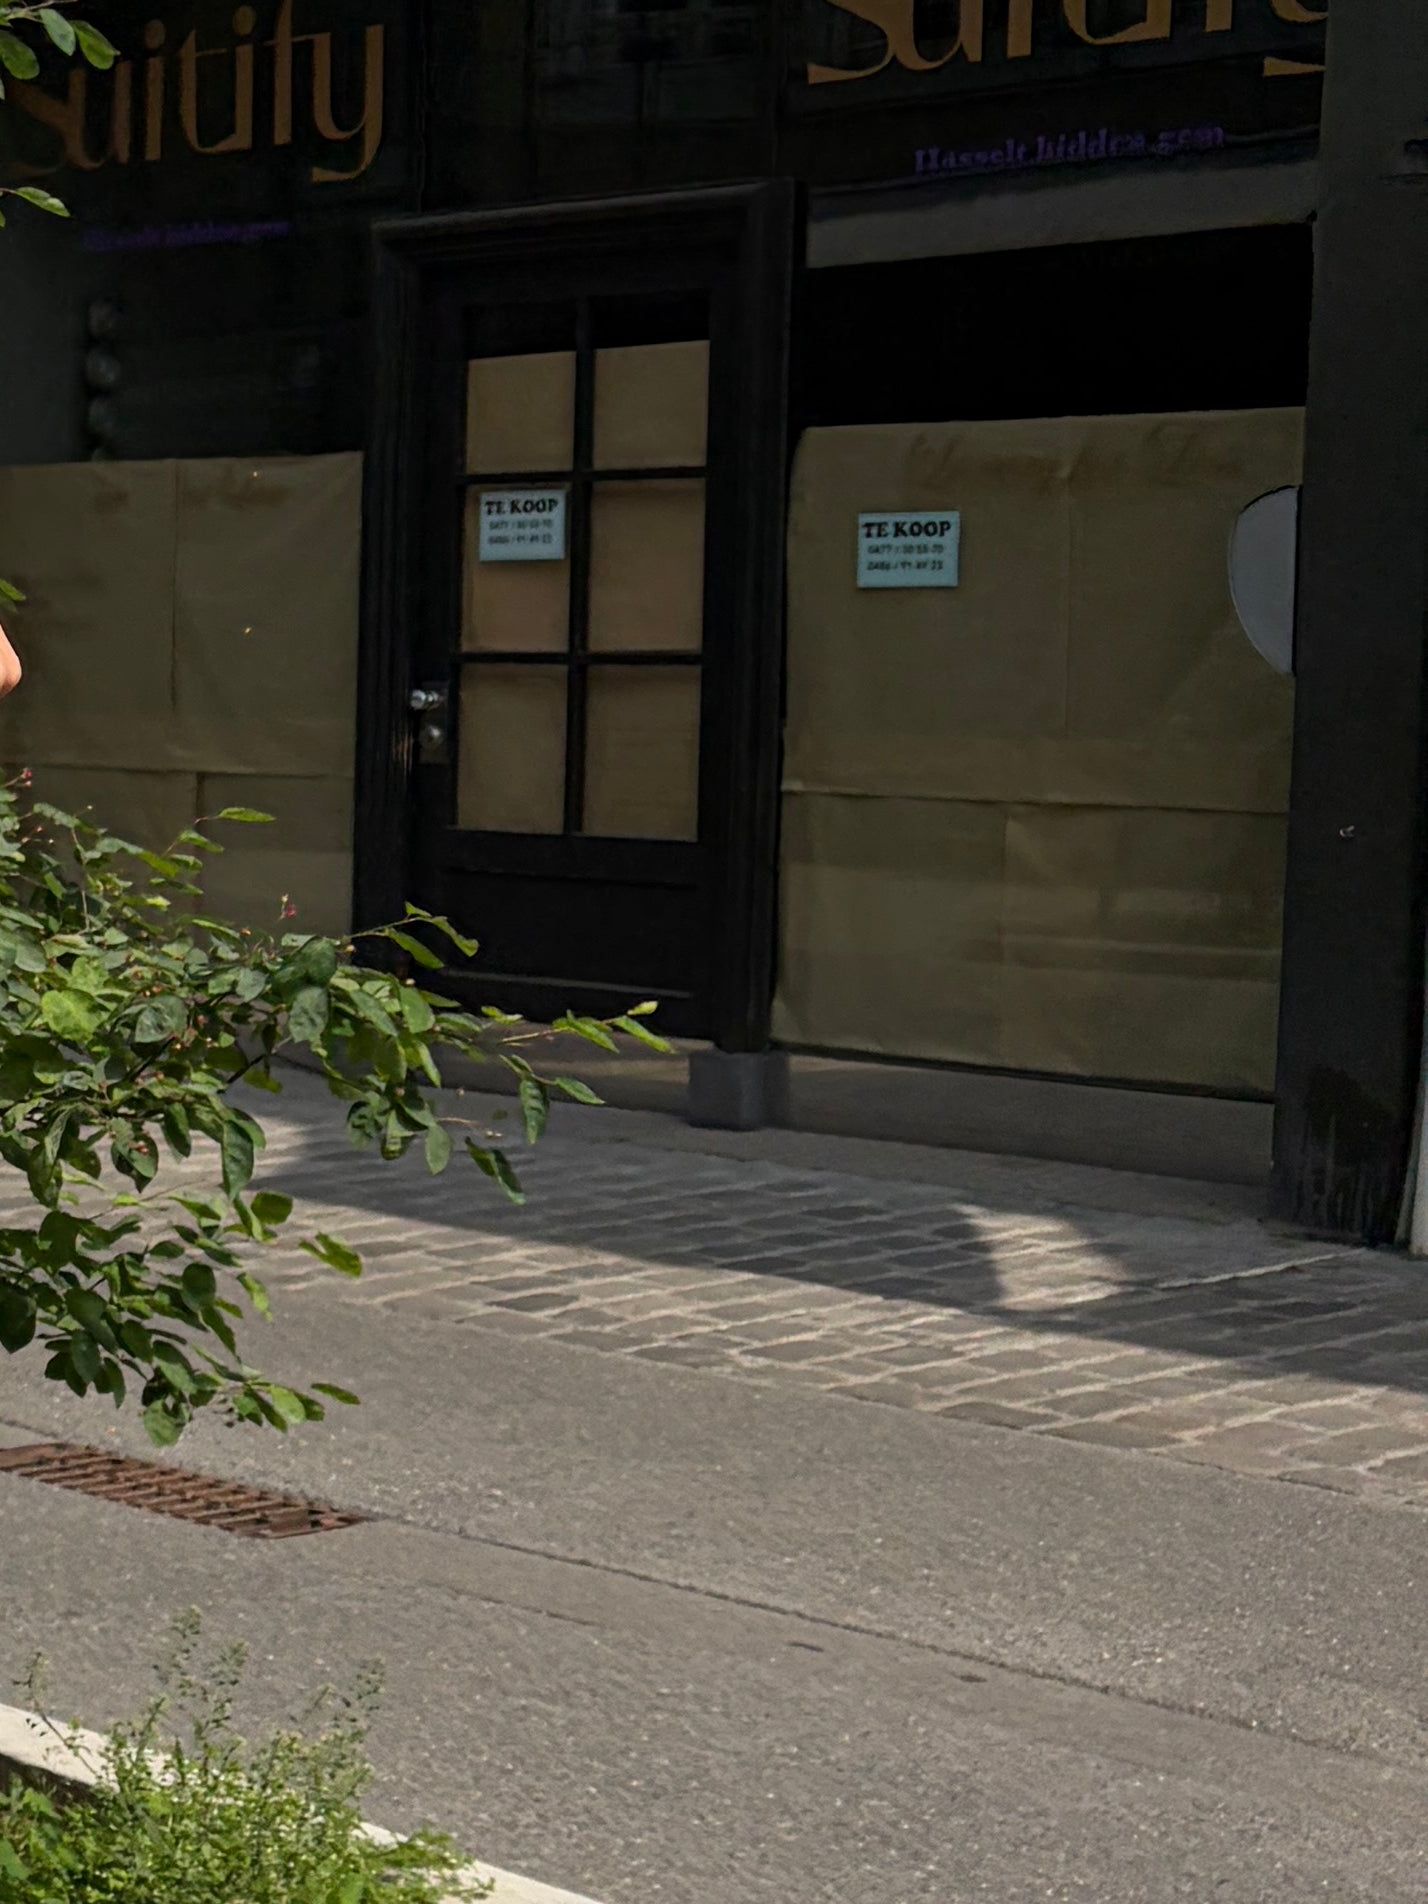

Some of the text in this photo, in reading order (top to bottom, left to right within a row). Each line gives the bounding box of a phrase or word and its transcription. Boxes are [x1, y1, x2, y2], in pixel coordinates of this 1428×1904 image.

[485, 498, 558, 515] TE KOOP
[862, 520, 952, 538] TE KOOP
